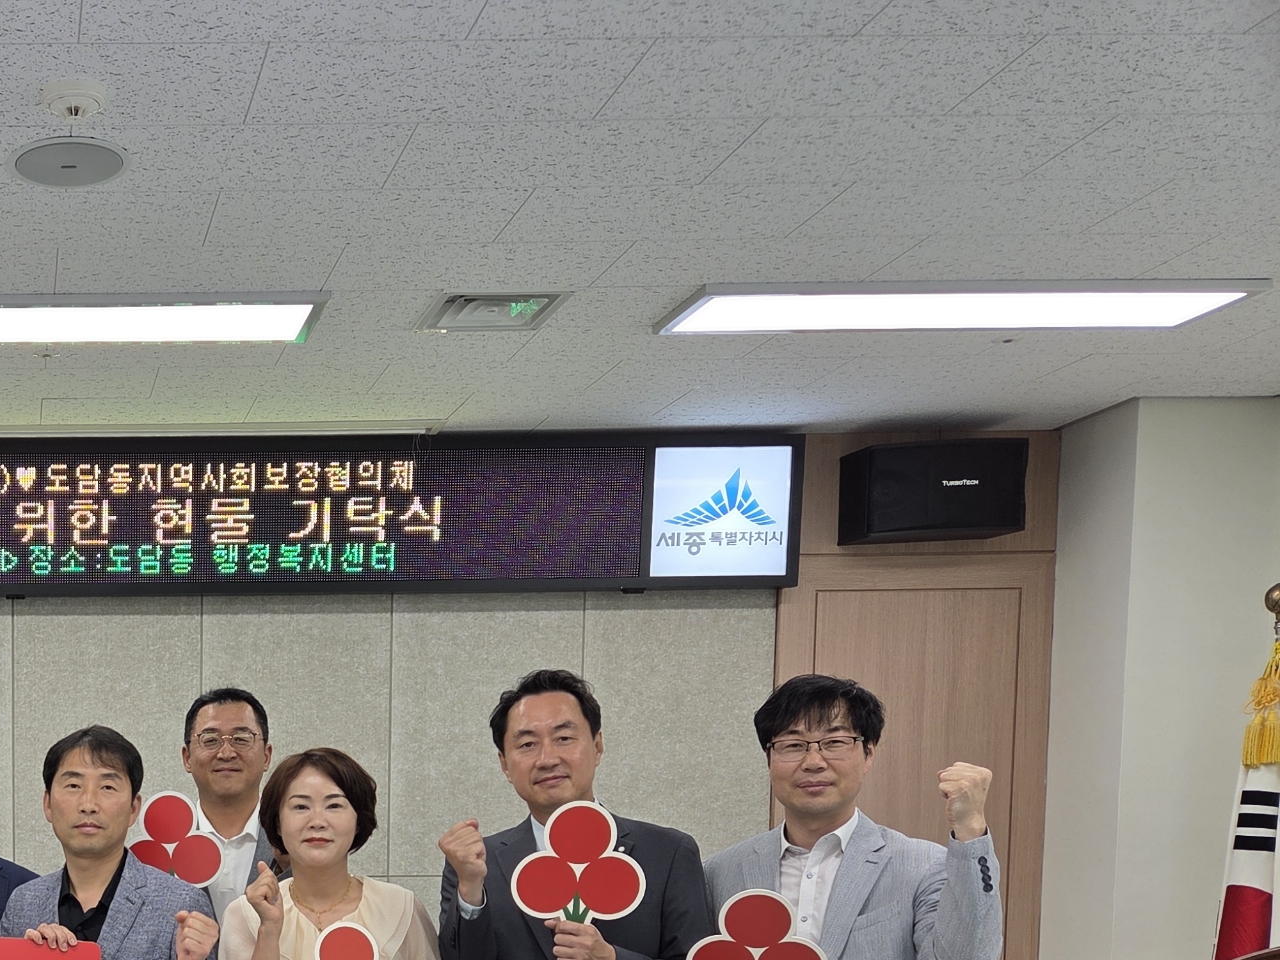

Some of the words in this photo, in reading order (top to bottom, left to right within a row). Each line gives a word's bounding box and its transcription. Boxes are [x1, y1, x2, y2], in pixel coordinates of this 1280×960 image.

[13, 498, 117, 545] 위한
[151, 498, 256, 544] 현물
[288, 495, 442, 543] 기탁식
[212, 543, 396, 574] 행정복지센터
